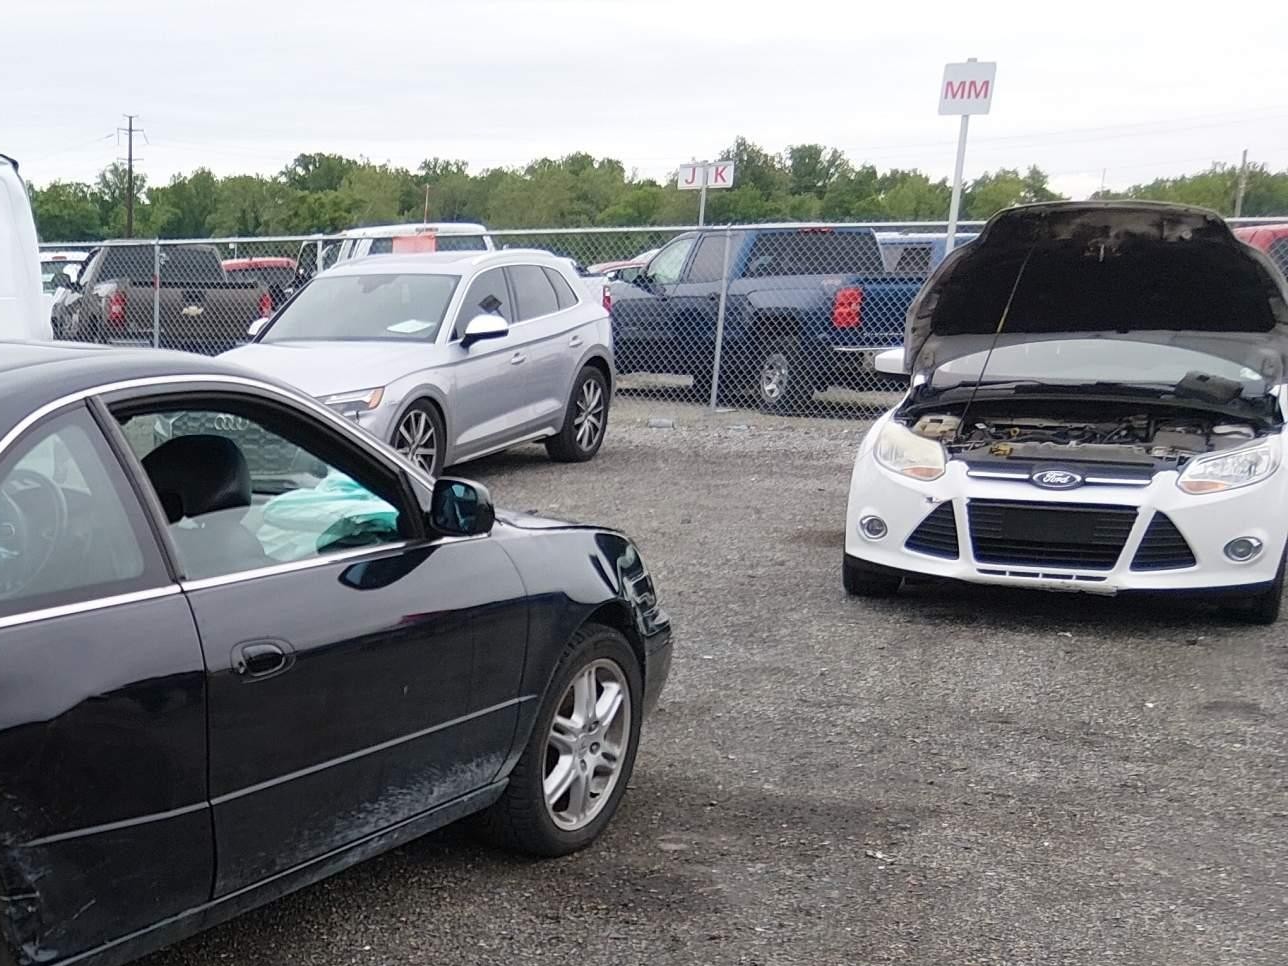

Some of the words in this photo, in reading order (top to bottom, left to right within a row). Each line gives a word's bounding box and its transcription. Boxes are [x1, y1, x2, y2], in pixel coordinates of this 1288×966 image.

[944, 80, 990, 100] MM
[685, 167, 696, 185] J
[714, 165, 728, 183] K
[1043, 470, 1071, 484] Ford
